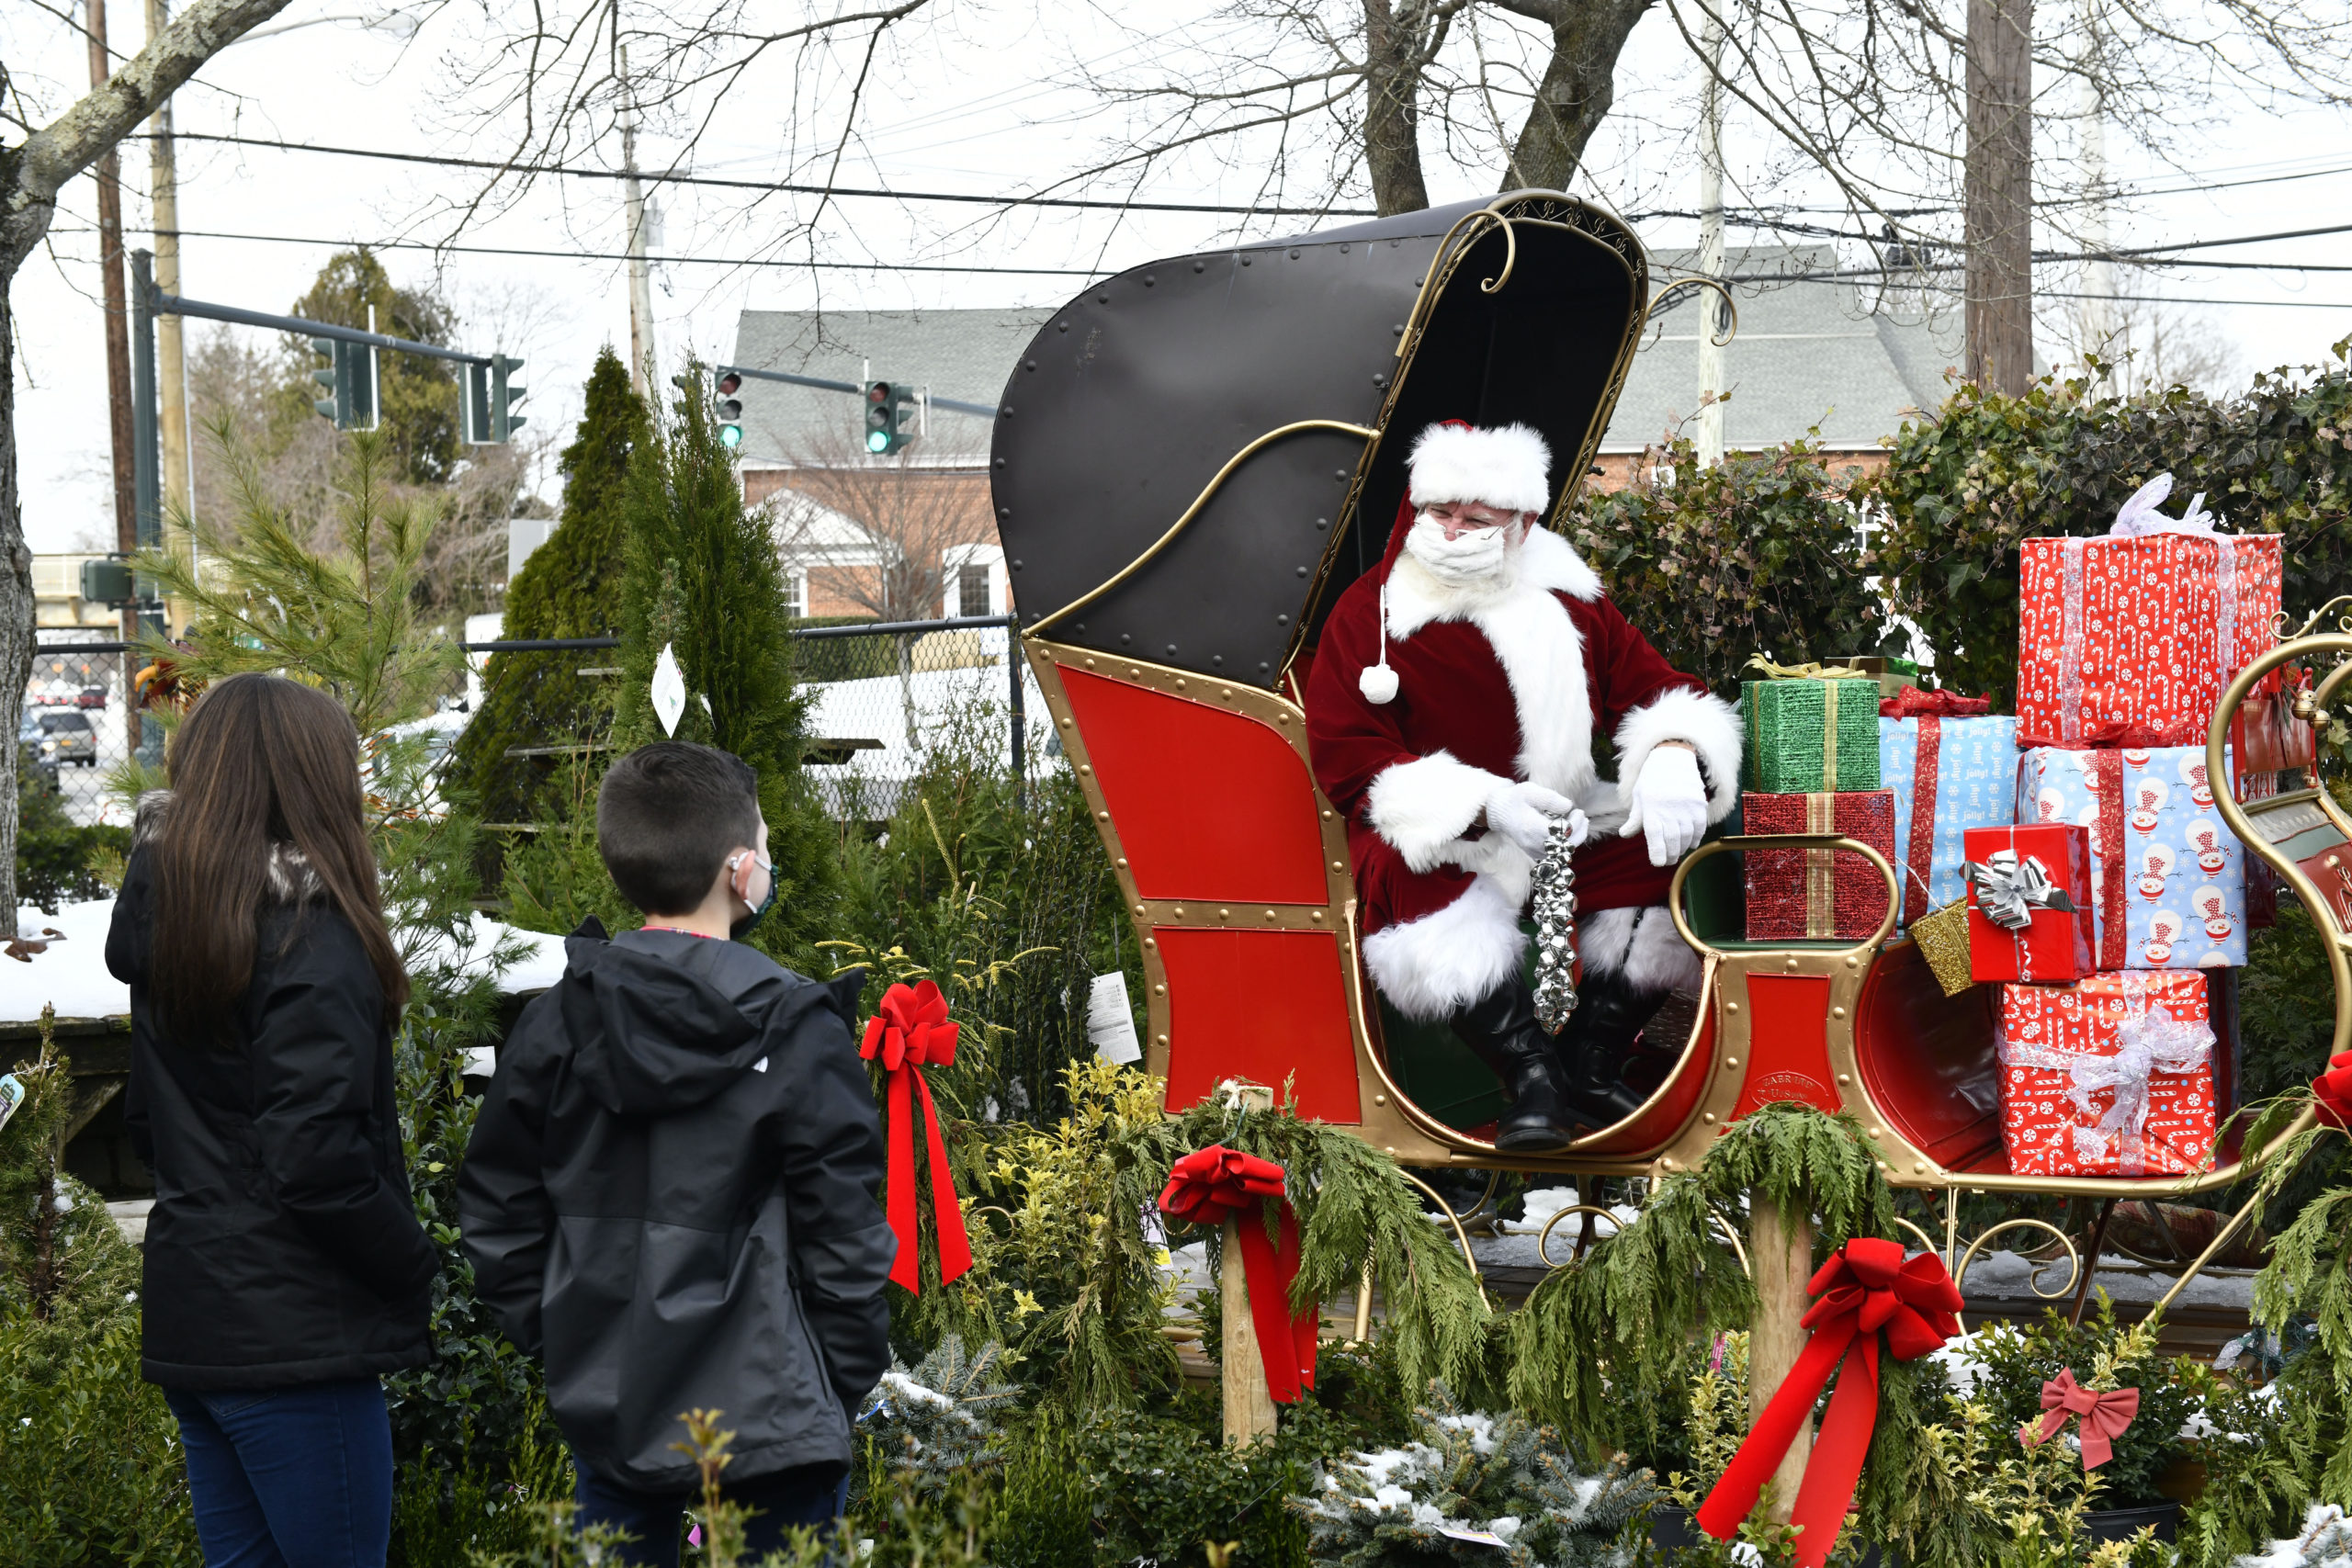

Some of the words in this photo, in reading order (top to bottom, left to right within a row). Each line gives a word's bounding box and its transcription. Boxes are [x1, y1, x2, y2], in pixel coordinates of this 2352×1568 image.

[1885, 731, 1909, 742] jolly!
[1968, 726, 1991, 739] jolly!
[1890, 746, 1902, 770] jolly!
[1973, 741, 1984, 766] jolly!
[1883, 773, 1906, 784] jolly!
[1950, 757, 1962, 782] jolly!
[1964, 768, 1988, 780] jolly!
[1991, 755, 2002, 779] jolly!
[1969, 784, 1981, 808] jolly!
[1948, 799, 1959, 824] jolly!
[1962, 809, 1985, 822] jolly!
[1988, 797, 1999, 821] jolly!
[1945, 841, 1956, 865] jolly!
